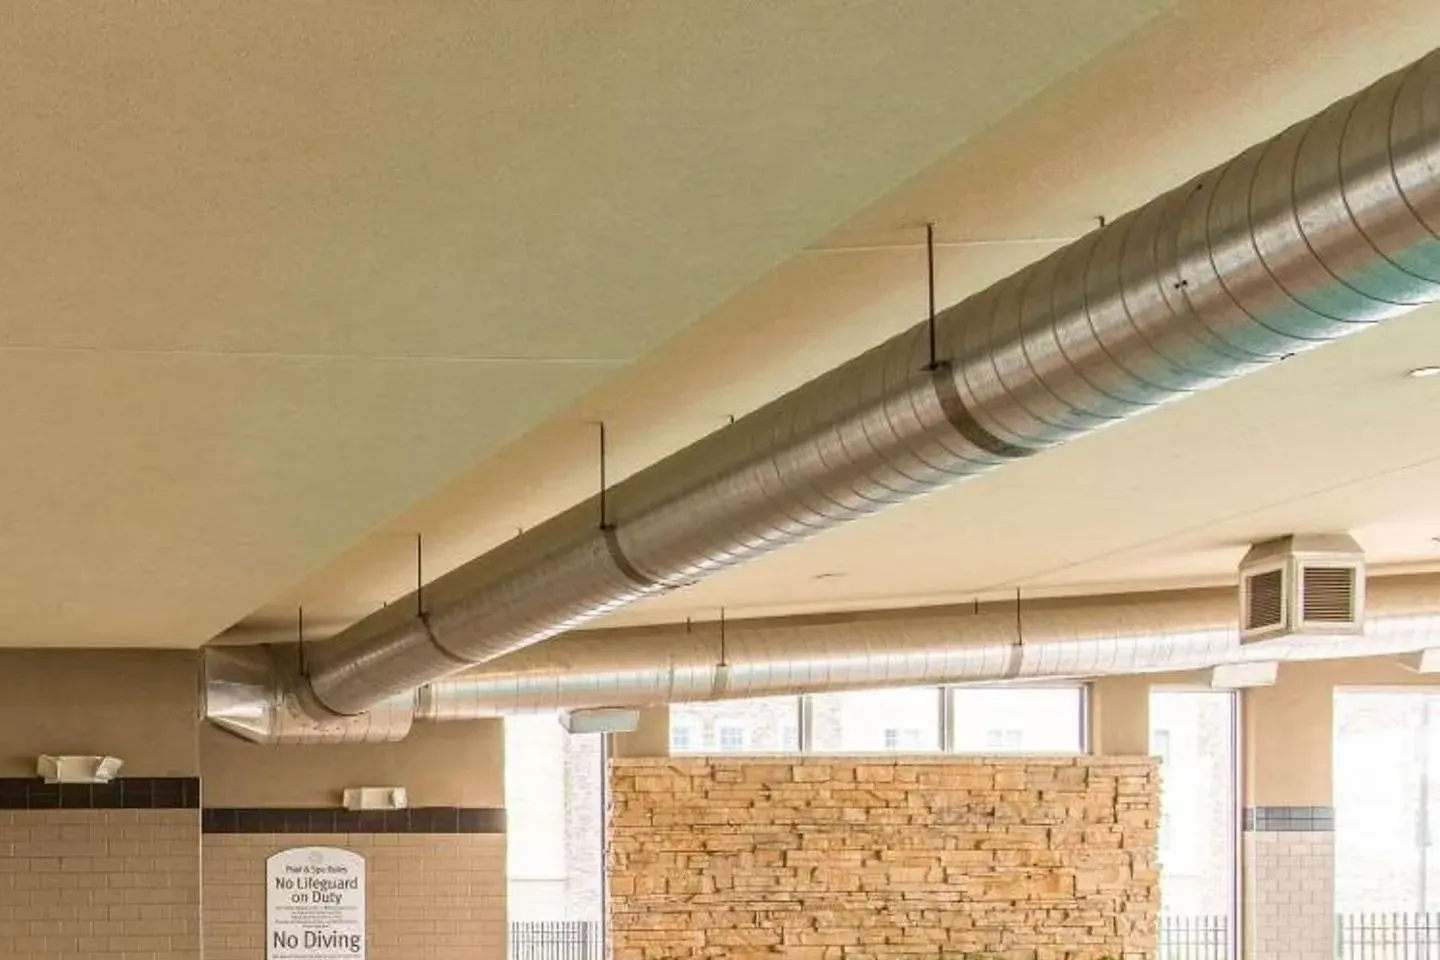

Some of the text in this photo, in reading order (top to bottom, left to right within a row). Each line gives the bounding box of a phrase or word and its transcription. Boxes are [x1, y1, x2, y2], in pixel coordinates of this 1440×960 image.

[275, 876, 359, 892] No Lifeguard
[291, 891, 343, 905] on Duty
[273, 929, 361, 953] No Diving
